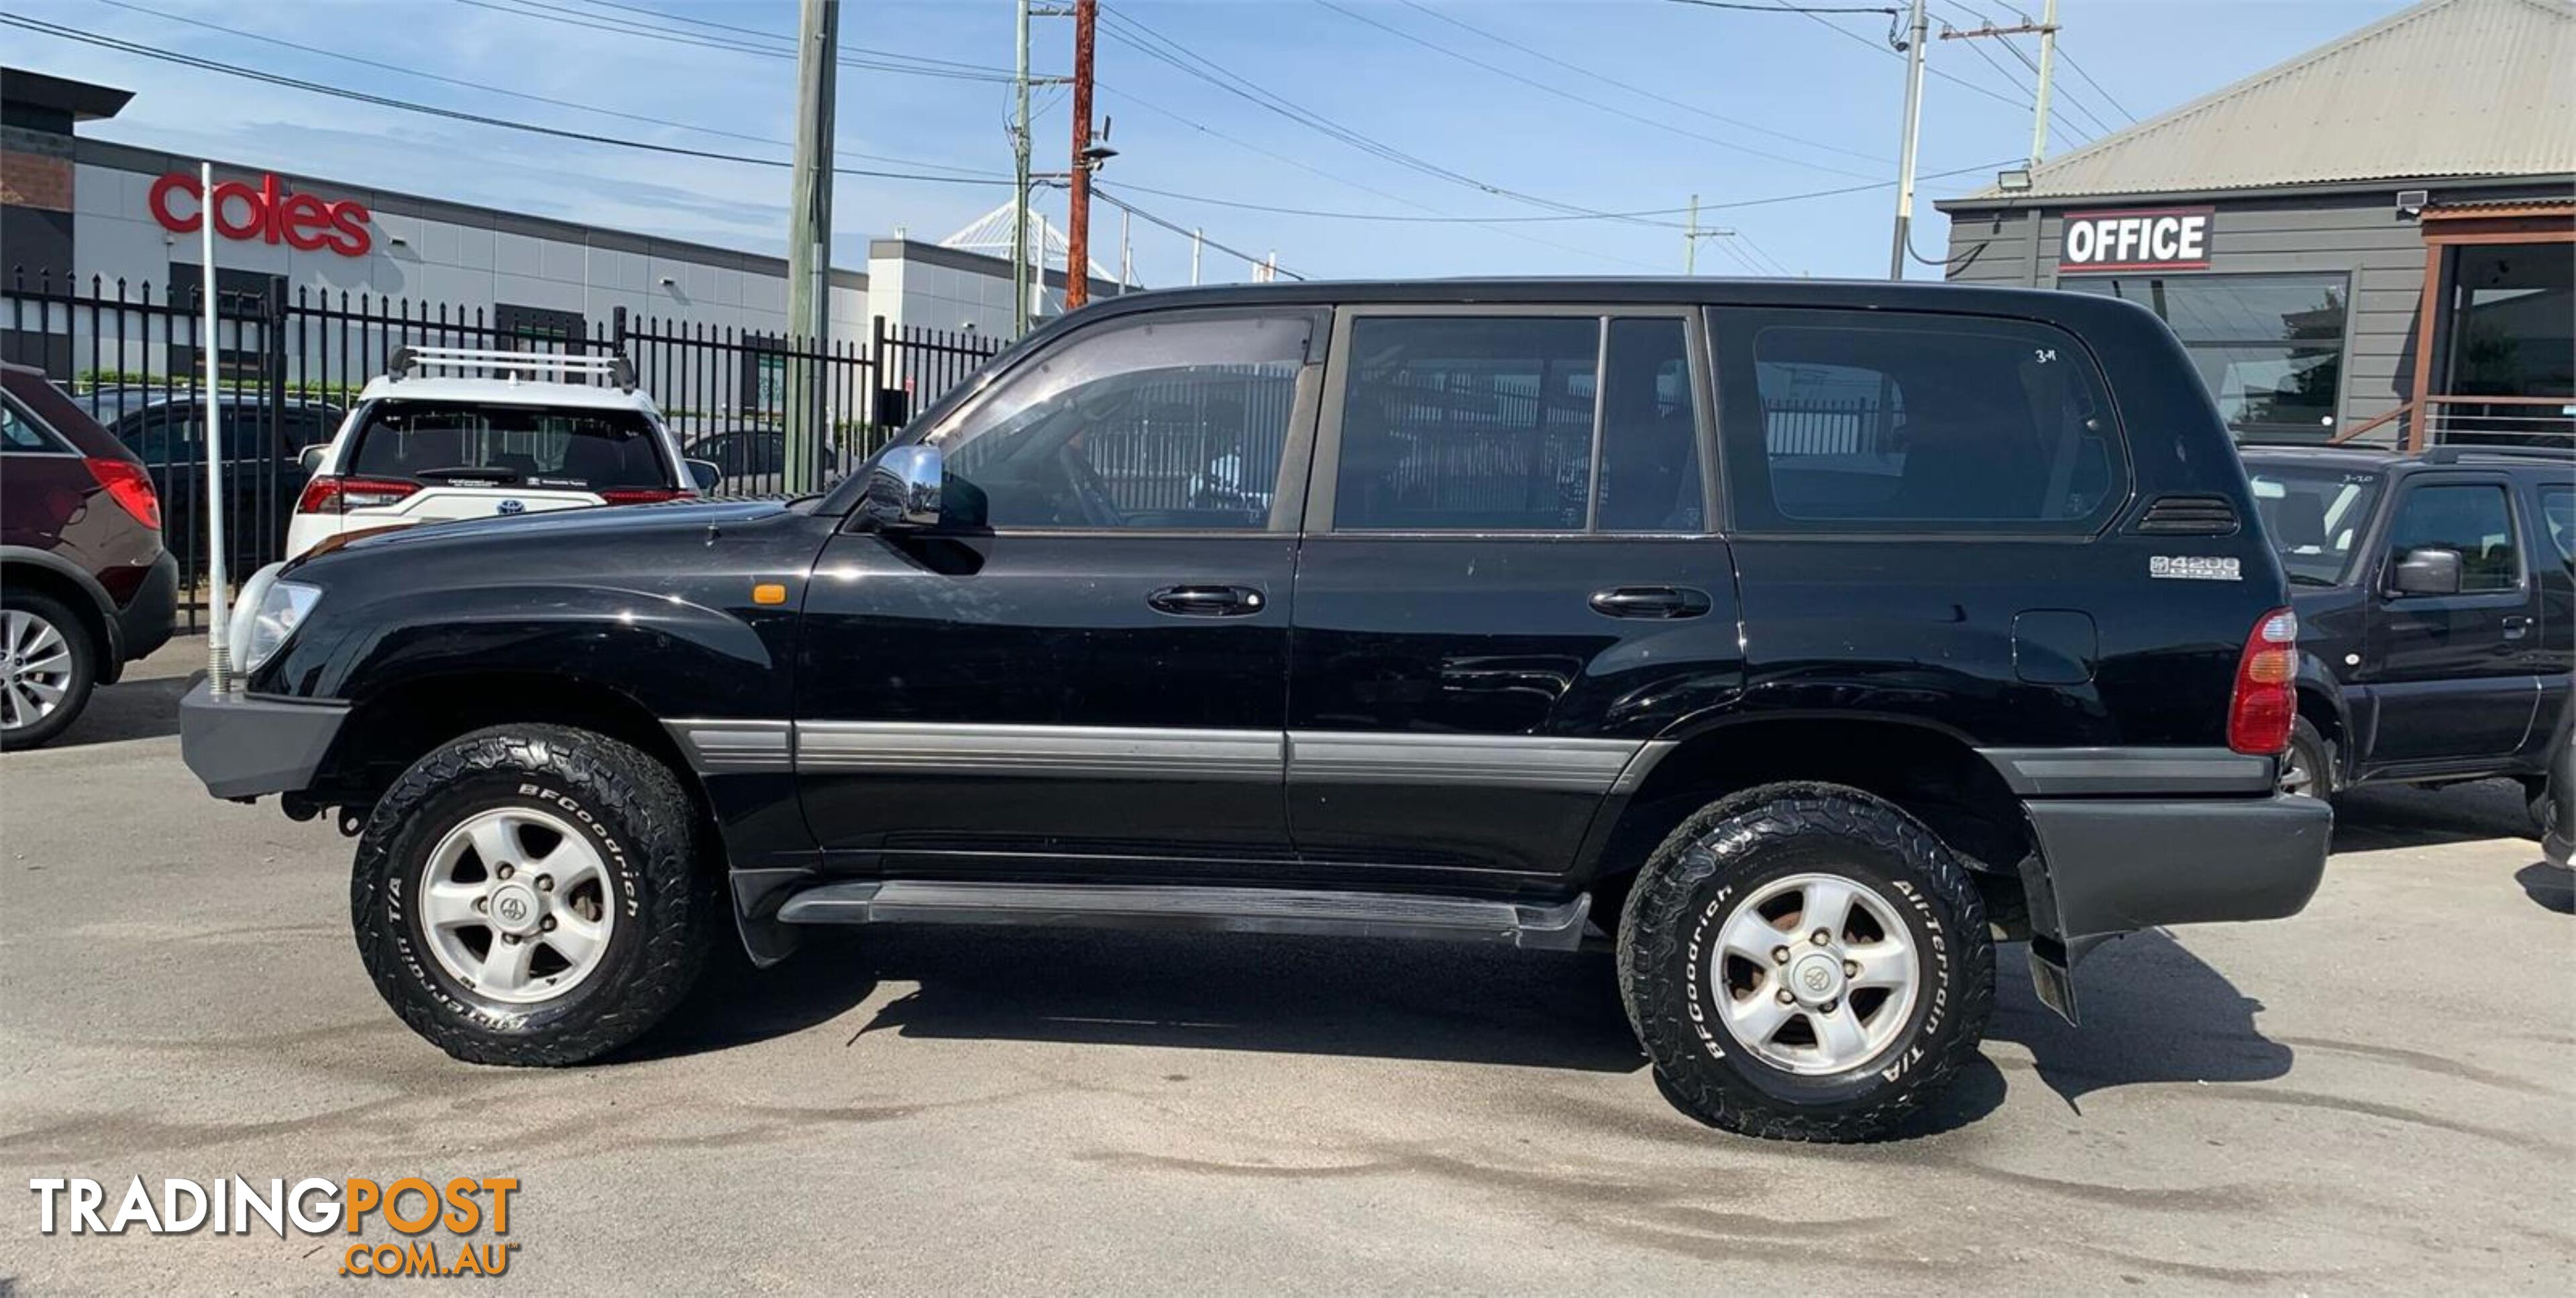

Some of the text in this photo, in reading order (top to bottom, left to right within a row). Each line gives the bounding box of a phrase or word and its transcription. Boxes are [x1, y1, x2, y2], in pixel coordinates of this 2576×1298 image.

[149, 170, 372, 257] coles
[2067, 216, 2205, 262] OFFICE
[2169, 555, 2240, 570] 4200
[519, 783, 639, 916] BFGoodrich
[387, 877, 402, 924] T/A
[1686, 885, 1733, 1059] BFGoodrich
[1881, 879, 1949, 1083] All-Terrain T/A
